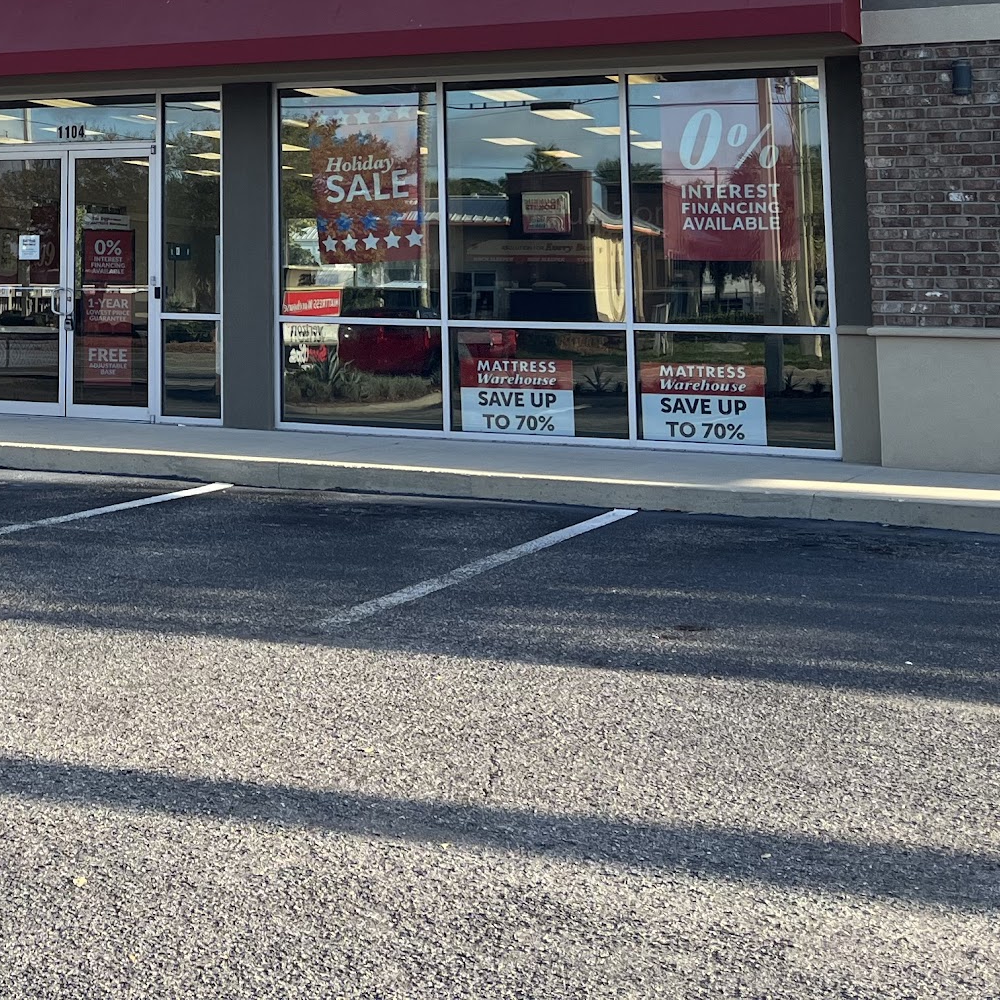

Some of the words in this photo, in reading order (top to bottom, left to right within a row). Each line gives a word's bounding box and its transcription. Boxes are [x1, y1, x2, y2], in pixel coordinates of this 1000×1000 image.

[57, 125, 85, 139] 1104
[678, 108, 780, 170] 0%
[325, 154, 395, 174] Holiday
[326, 168, 410, 204] SALE
[681, 184, 780, 199] INTEREST
[682, 202, 780, 215] FINANCING
[682, 216, 781, 231] AVAILABLE
[94, 239, 122, 256] 0%
[88, 297, 129, 309] 1-YEAR
[88, 348, 127, 363] FREE
[89, 362, 128, 370] ADJUSTABLE
[477, 360, 556, 374] MATTRESS
[659, 365, 746, 379] MATTRESS
[477, 373, 556, 387] Warehouse
[660, 379, 747, 393] Warehouse
[478, 391, 525, 408] SAVE
[529, 393, 557, 408] UP
[660, 397, 711, 414] SAVE
[718, 399, 747, 415] UP
[482, 414, 509, 429] TO
[515, 415, 555, 431] 70%
[665, 421, 696, 437] TO
[702, 423, 745, 441] 70%
